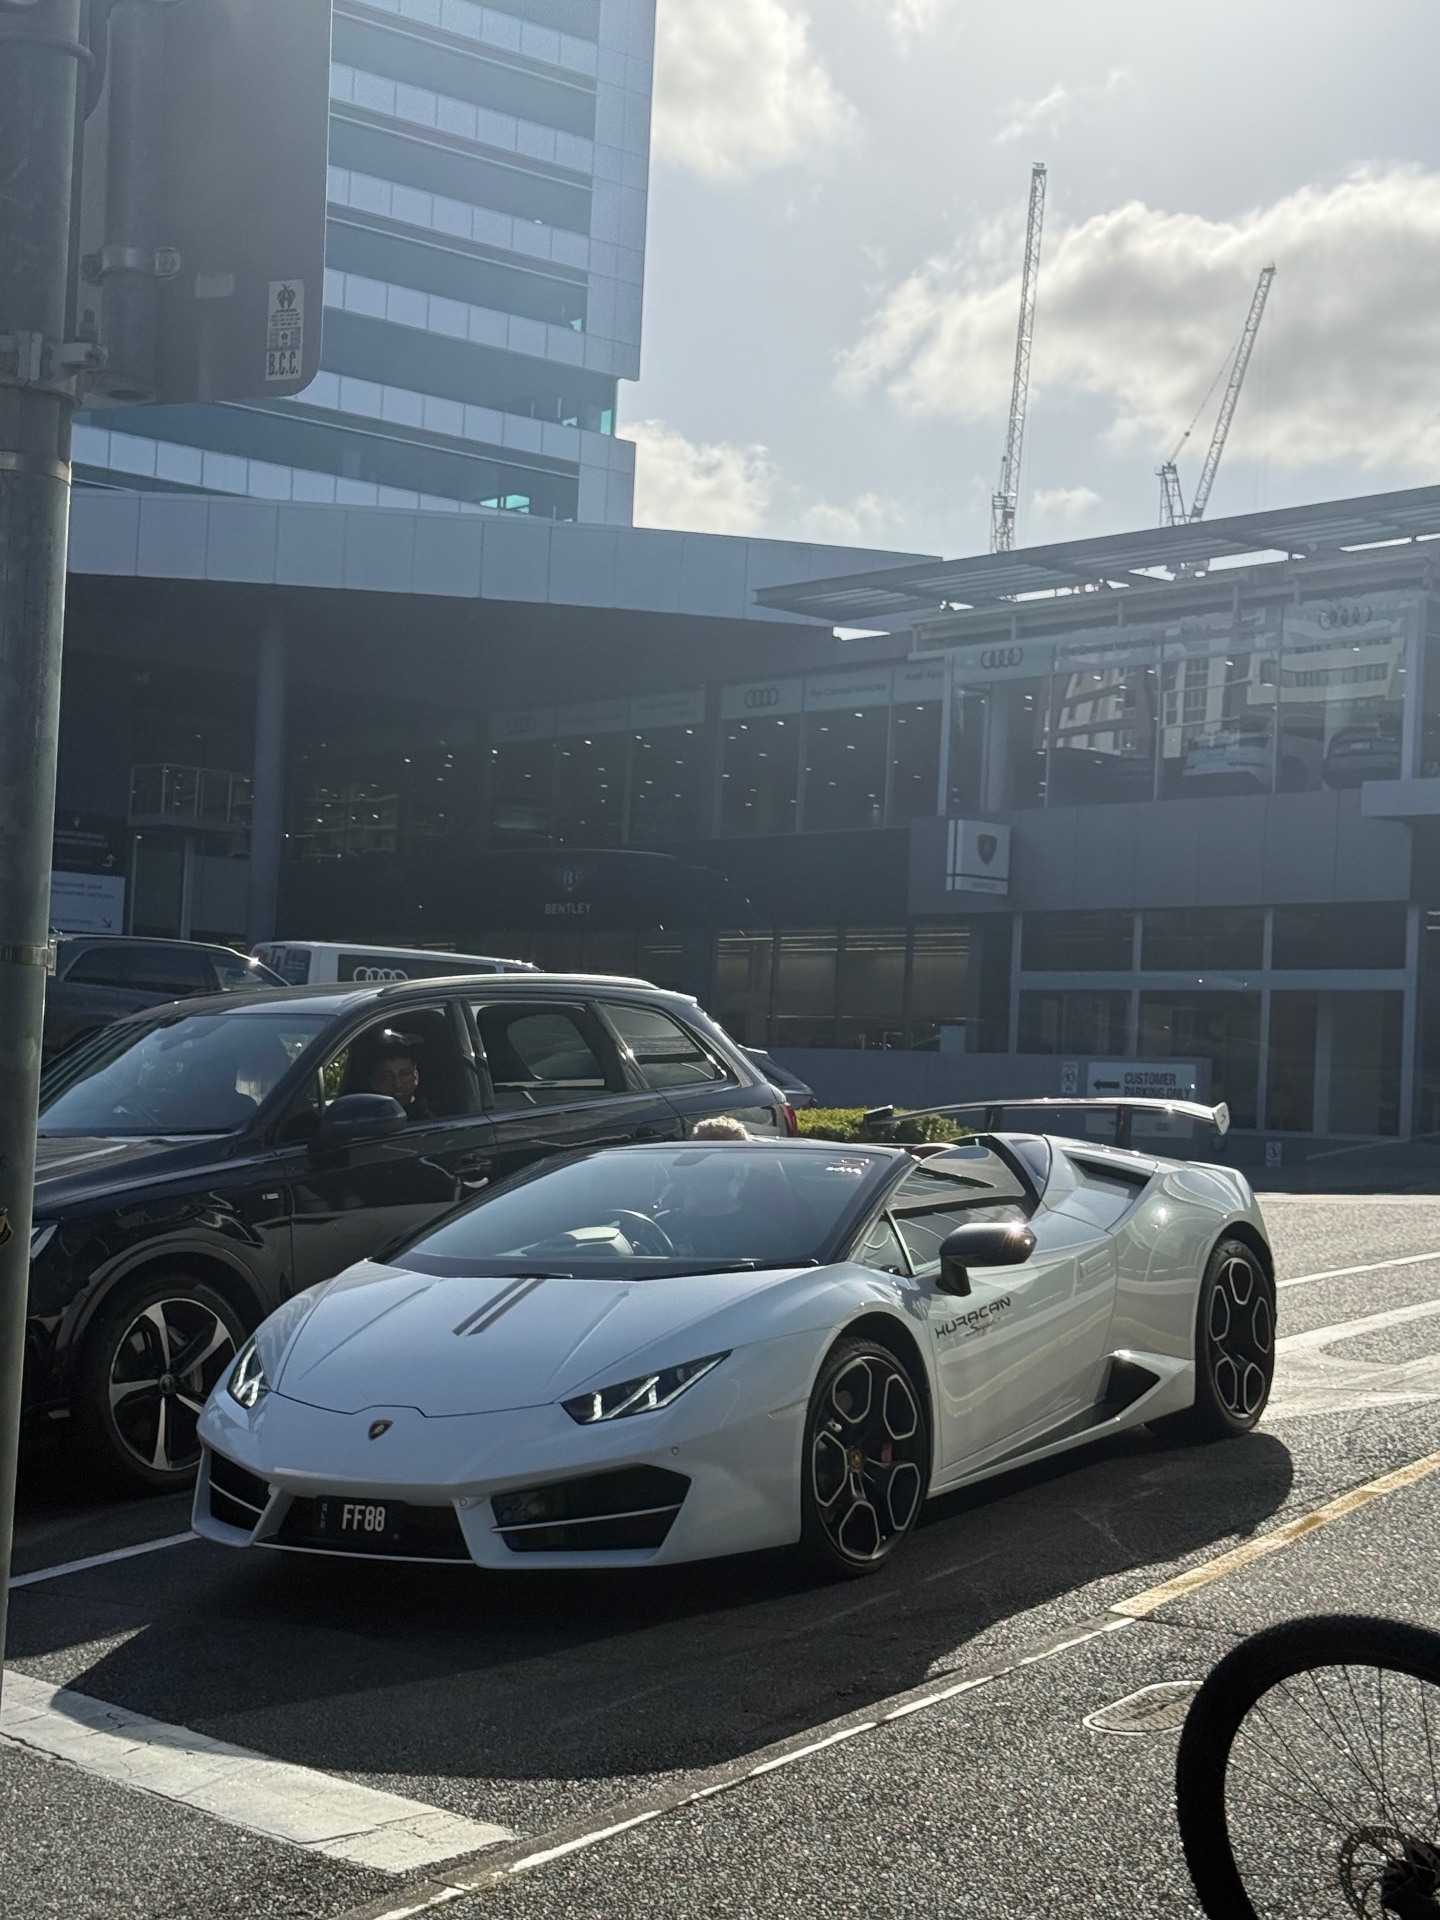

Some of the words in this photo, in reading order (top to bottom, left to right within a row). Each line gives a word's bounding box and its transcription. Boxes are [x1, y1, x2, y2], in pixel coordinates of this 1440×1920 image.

[269, 351, 299, 375] B.C.C.
[544, 902, 592, 915] BENTLEY
[1124, 1072, 1176, 1085] CUSTOMER
[1123, 1086, 1164, 1098] PARKING
[1166, 1087, 1190, 1099] ONLY
[934, 1296, 1011, 1339] HURACAN
[342, 1504, 386, 1532] FF88
